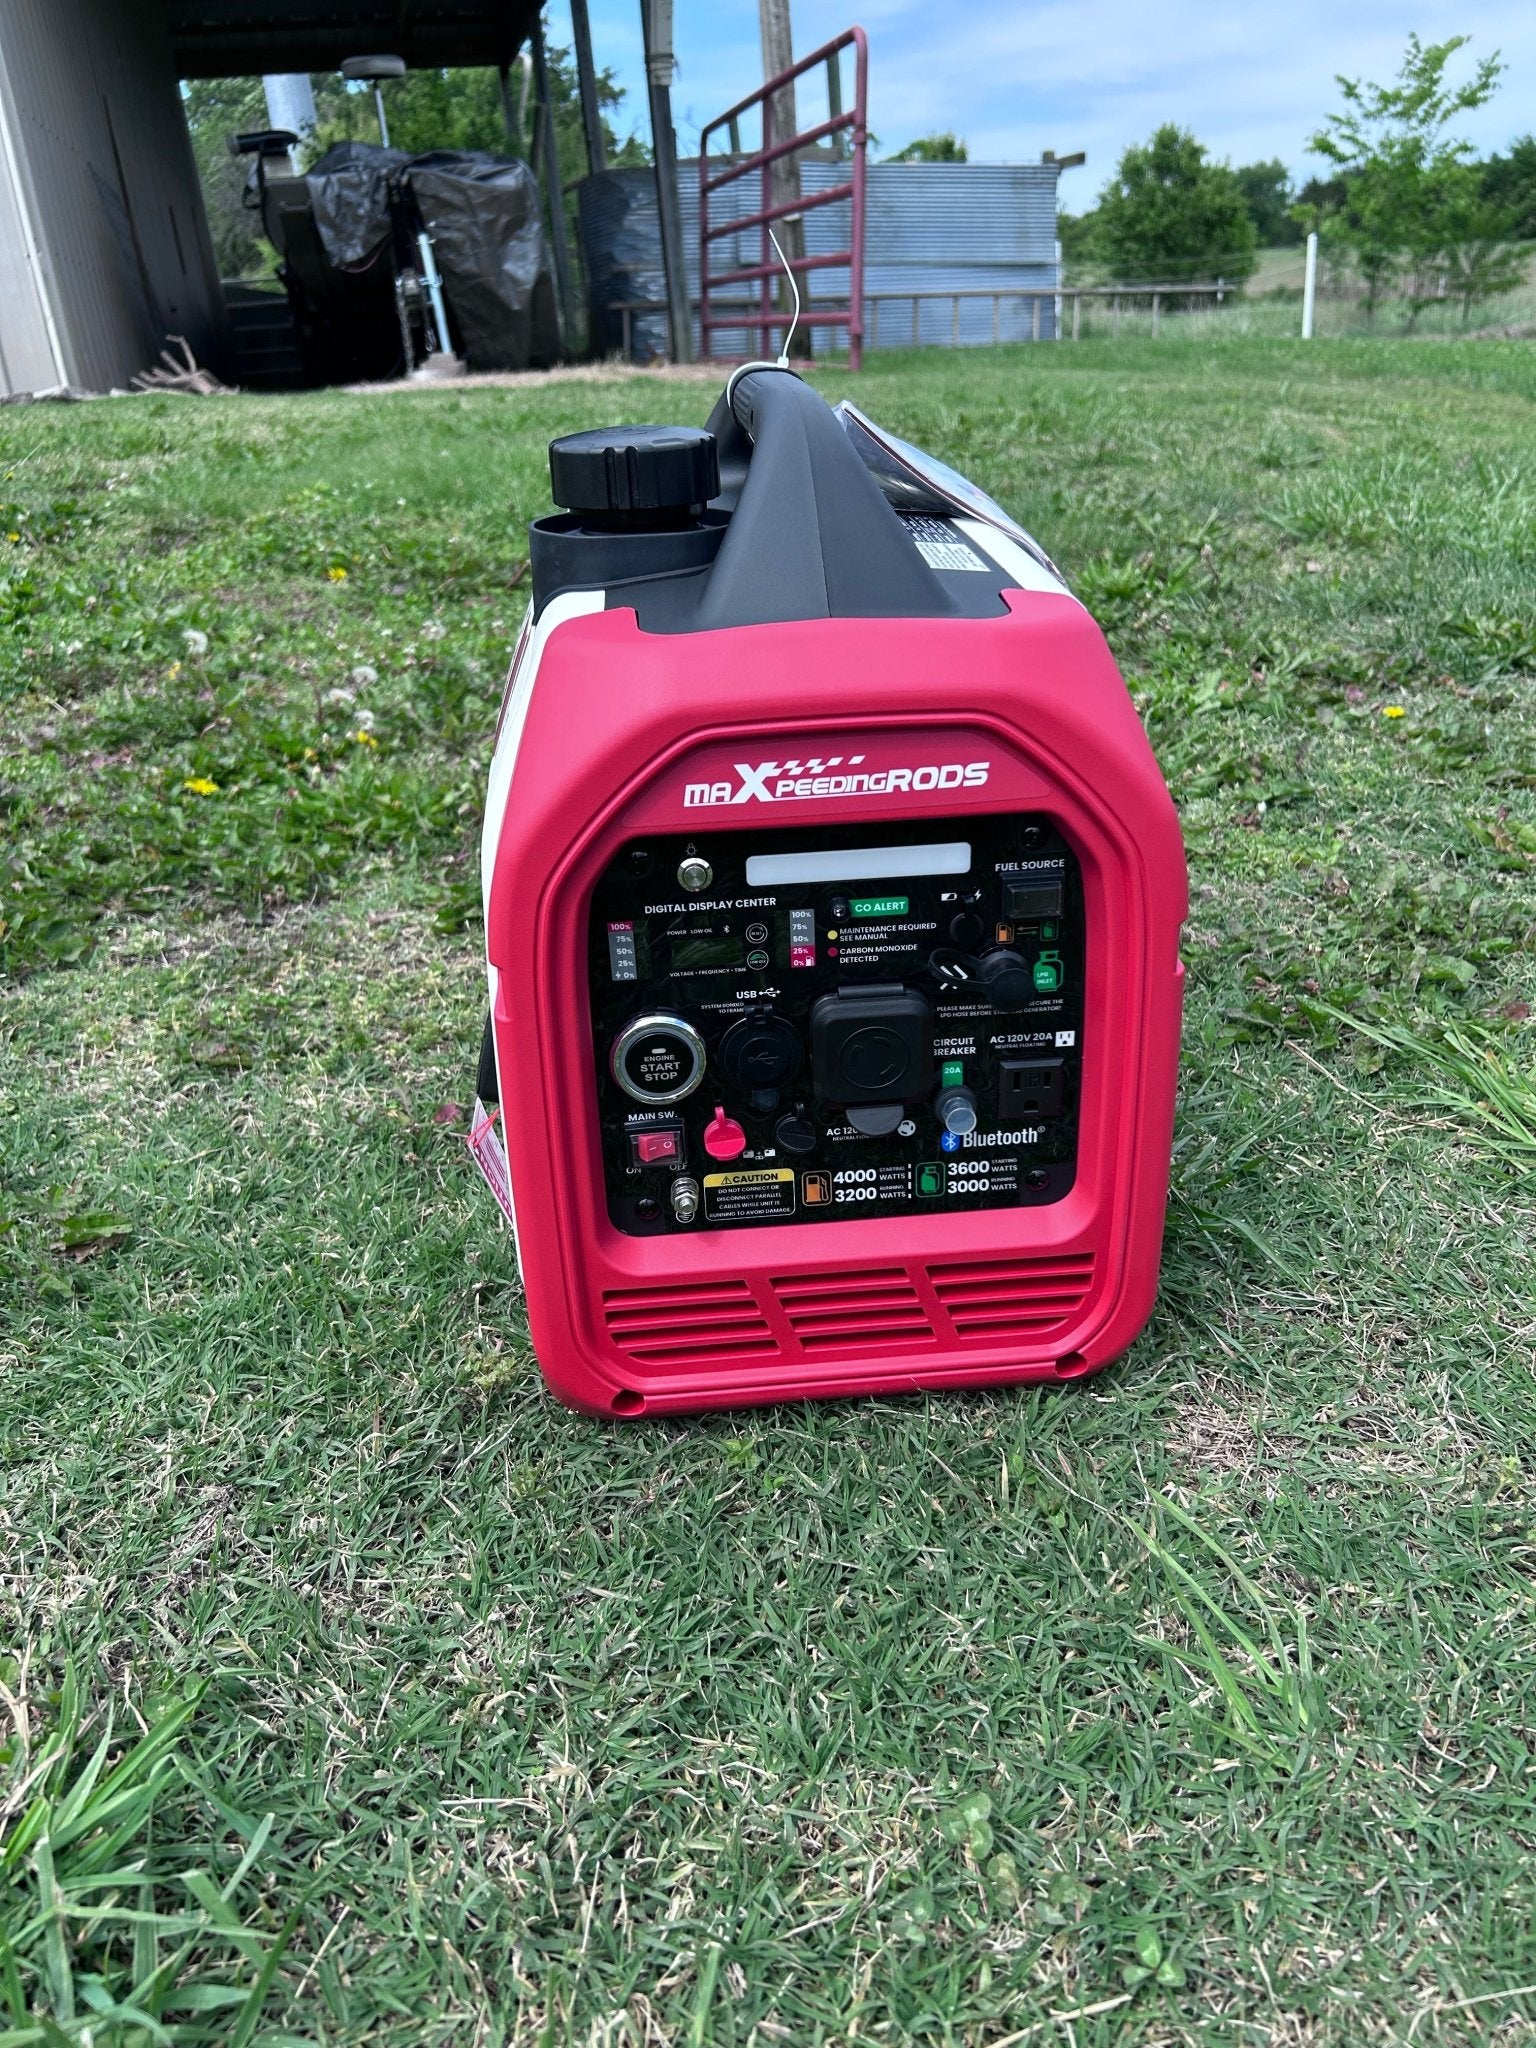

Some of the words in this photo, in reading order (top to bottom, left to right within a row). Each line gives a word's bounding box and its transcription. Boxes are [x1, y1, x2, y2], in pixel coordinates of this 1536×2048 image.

[995, 862, 1019, 872] FUEL
[1021, 859, 1065, 870] SOURCE
[644, 904, 687, 914] DIGITAL
[688, 900, 733, 911] DISPLAY
[735, 897, 776, 908] CENTER
[855, 903, 871, 912] CO
[873, 901, 906, 911] ALERT
[840, 925, 896, 935] MAINTENANCE
[898, 922, 936, 931] REQUIRED
[854, 932, 888, 941] MANUAL
[840, 947, 874, 955] CARBON
[875, 944, 918, 953] MONOXIDE
[840, 955, 879, 964] DETECTED
[736, 990, 757, 999] USB
[933, 1037, 974, 1046] CIRCUIT
[990, 1035, 1005, 1044] AC
[1007, 1033, 1031, 1042] 120V
[1033, 1032, 1053, 1041] 20A
[644, 1054, 675, 1062] ENGINE
[640, 1061, 681, 1072] START
[944, 1066, 961, 1074] 20A
[644, 1071, 678, 1081] STOP
[628, 1112, 656, 1122] MAIN
[658, 1111, 677, 1119] SW.
[826, 1128, 841, 1136] AC
[669, 1162, 688, 1171] OFF
[948, 1160, 990, 1175] 3600
[732, 1173, 778, 1183] CAUTION
[833, 1169, 877, 1184] 4000
[879, 1173, 906, 1181] WATTS
[948, 1179, 990, 1193] 3000
[834, 1187, 877, 1202] 3200
[879, 1191, 906, 1199] WATTS
